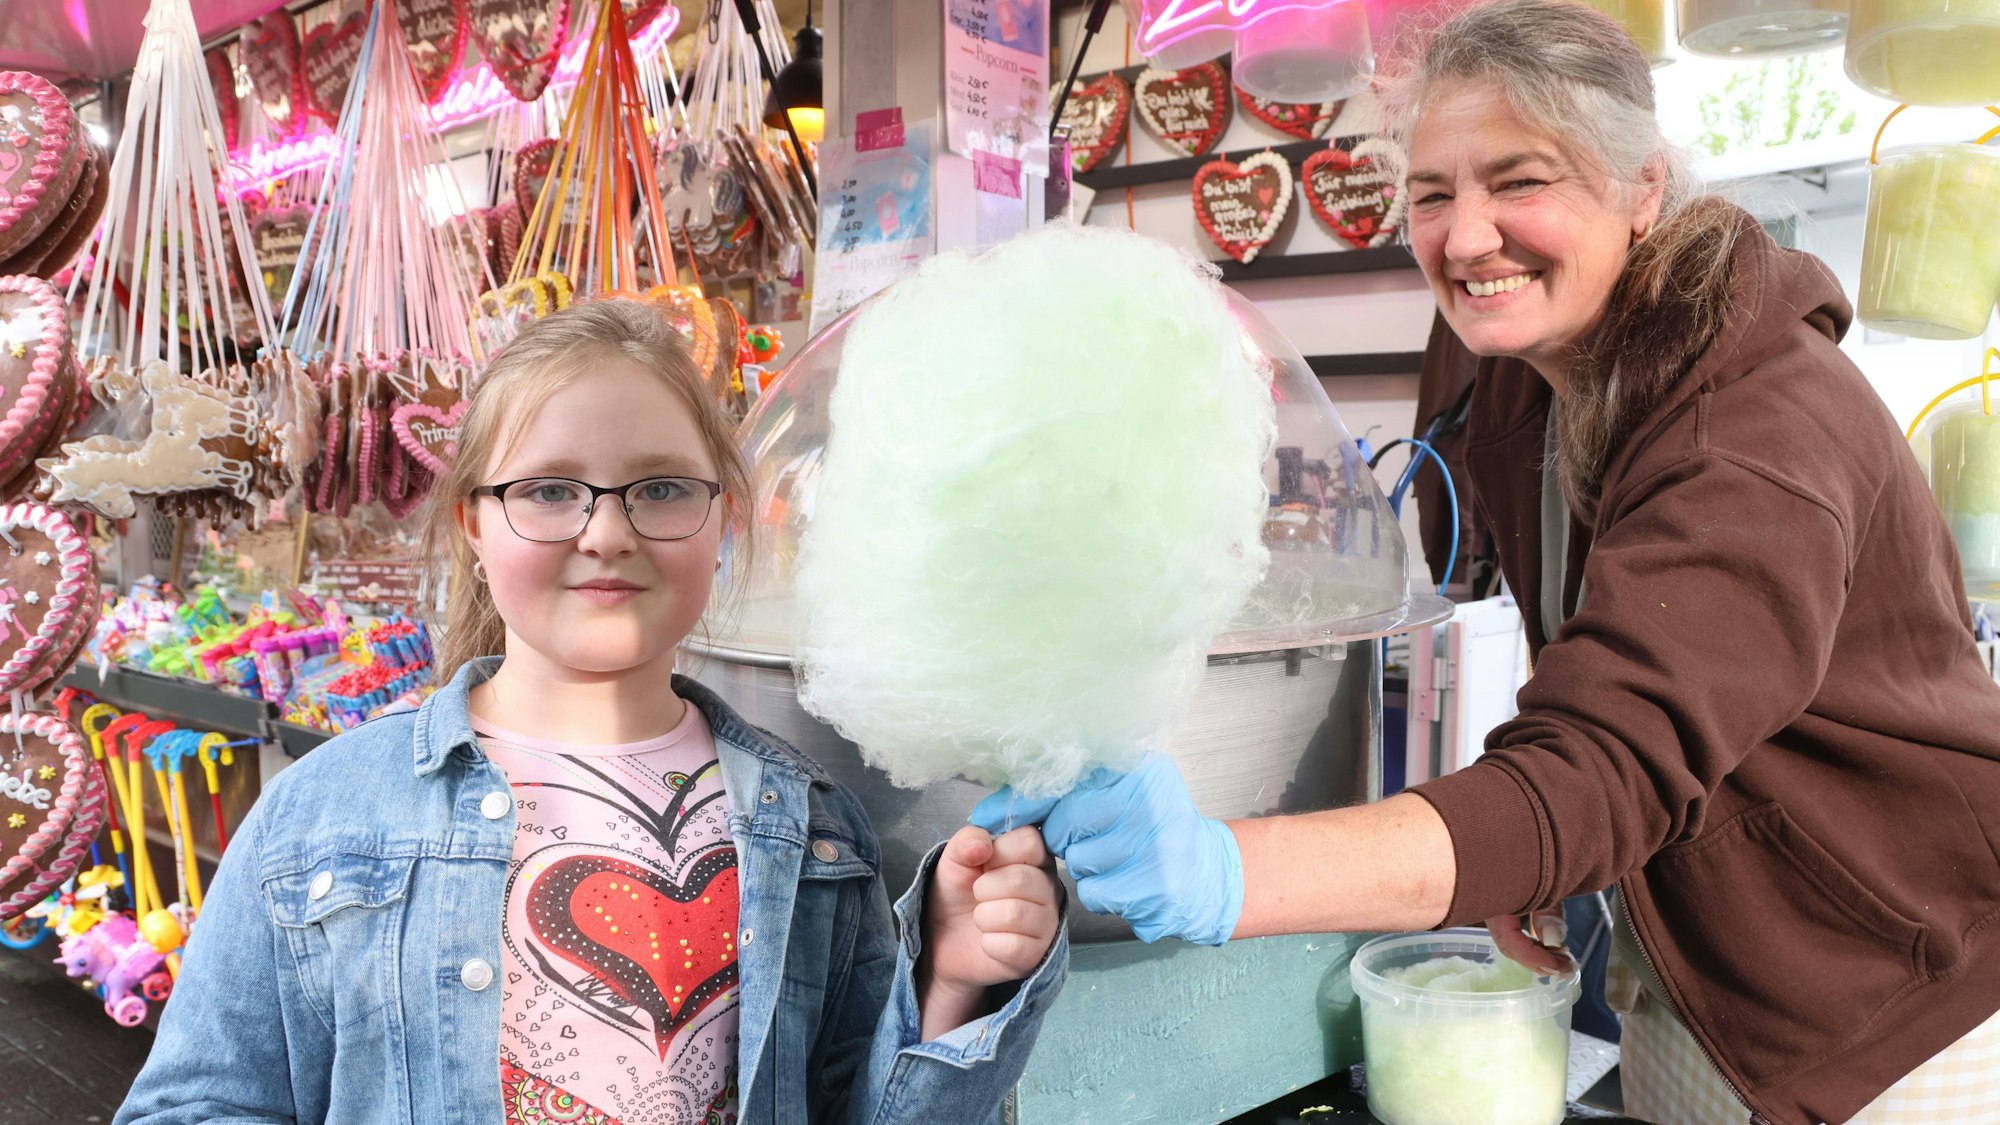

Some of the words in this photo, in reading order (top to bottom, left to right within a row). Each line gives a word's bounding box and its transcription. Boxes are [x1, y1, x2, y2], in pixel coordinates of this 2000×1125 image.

[975, 43, 1019, 73] Popcorn
[1202, 180, 1225, 198] Du
[1322, 191, 1385, 215] Liebling
